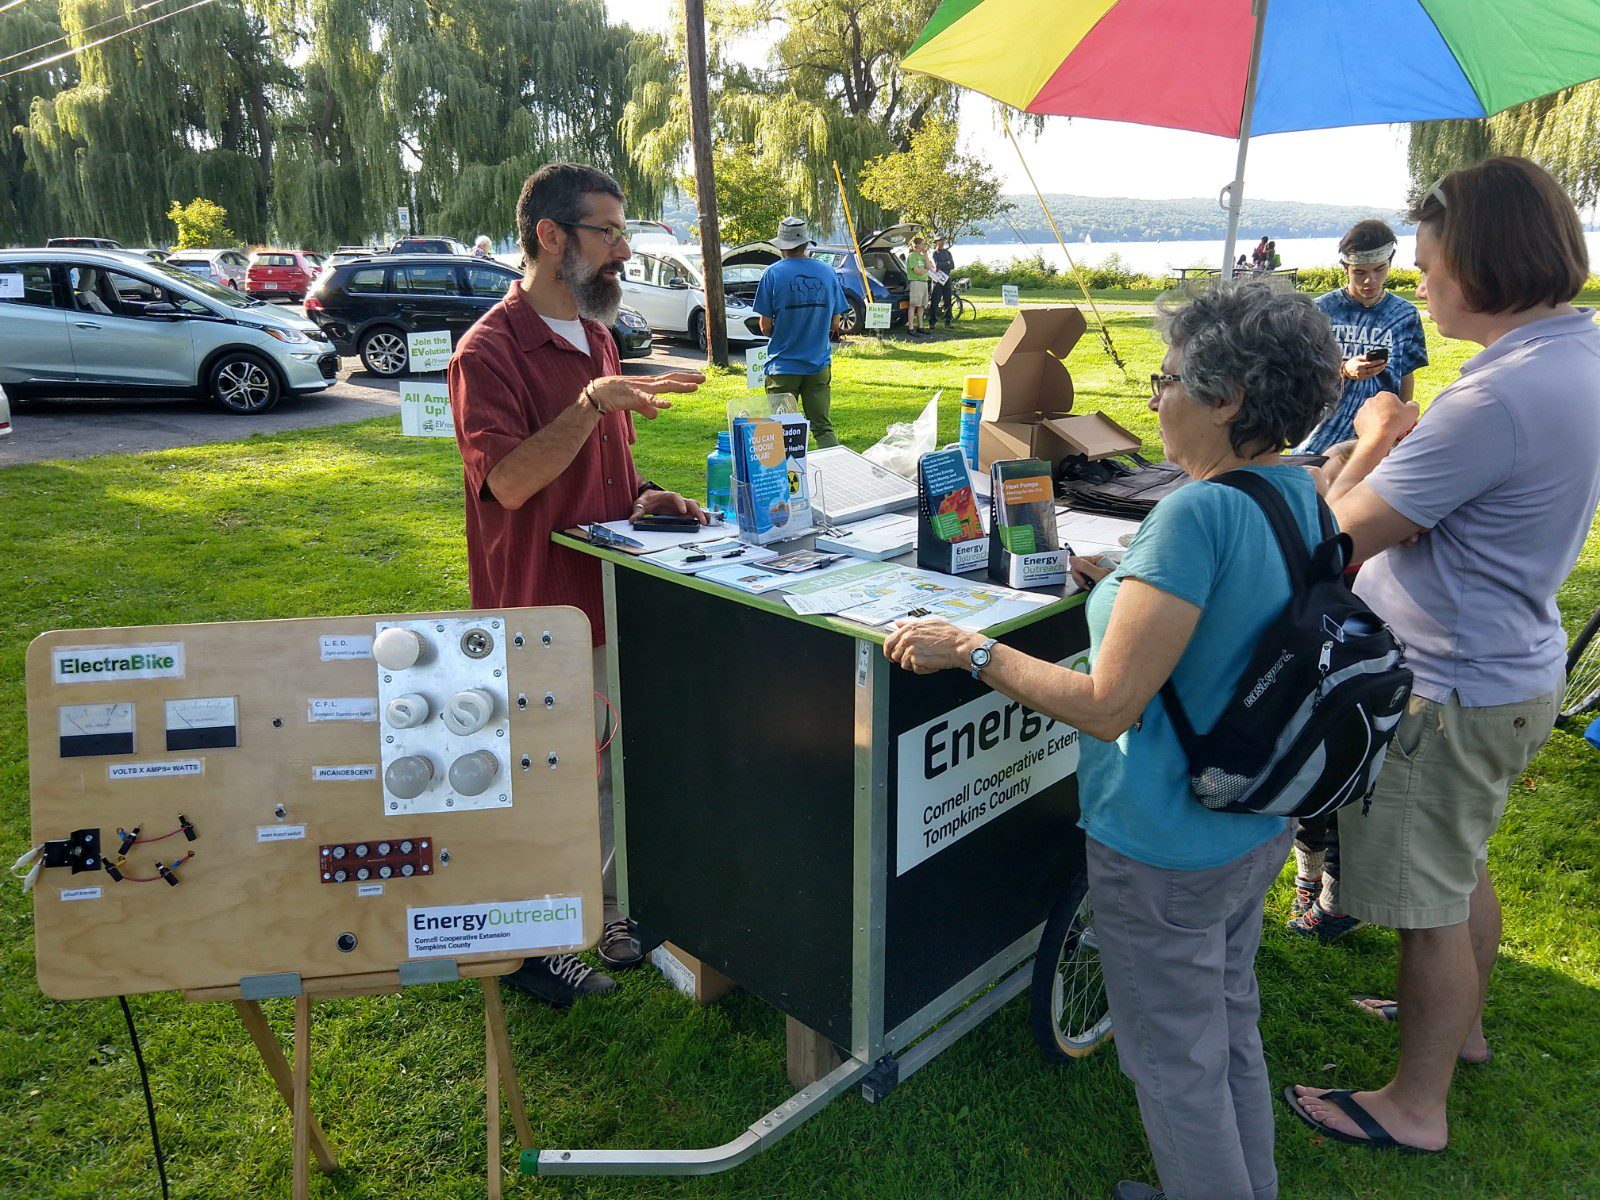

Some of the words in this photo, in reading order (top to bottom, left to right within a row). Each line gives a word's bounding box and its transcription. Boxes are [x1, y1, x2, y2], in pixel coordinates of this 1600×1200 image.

[1332, 324, 1393, 346] THACA
[413, 338, 432, 346] Join
[411, 348, 450, 357] EVolution
[404, 392, 420, 402] All
[424, 394, 450, 406] Amp
[425, 405, 446, 416] Up!
[762, 434, 775, 442] CAN
[749, 443, 774, 452] CHOOSE
[956, 544, 984, 555] Energy
[1024, 556, 1058, 565] Energy
[1023, 564, 1064, 574] Outreach
[60, 654, 174, 674] ElectraBike
[924, 700, 1057, 780] Energ
[923, 783, 970, 825] Cornell
[973, 747, 1044, 797] Cooperative
[1047, 729, 1079, 756] Exten
[923, 801, 986, 848] Tompkins
[989, 775, 1032, 810] County
[439, 934, 478, 943] Cooperative
[479, 931, 510, 940] Extension
[415, 944, 447, 952] Tompkins
